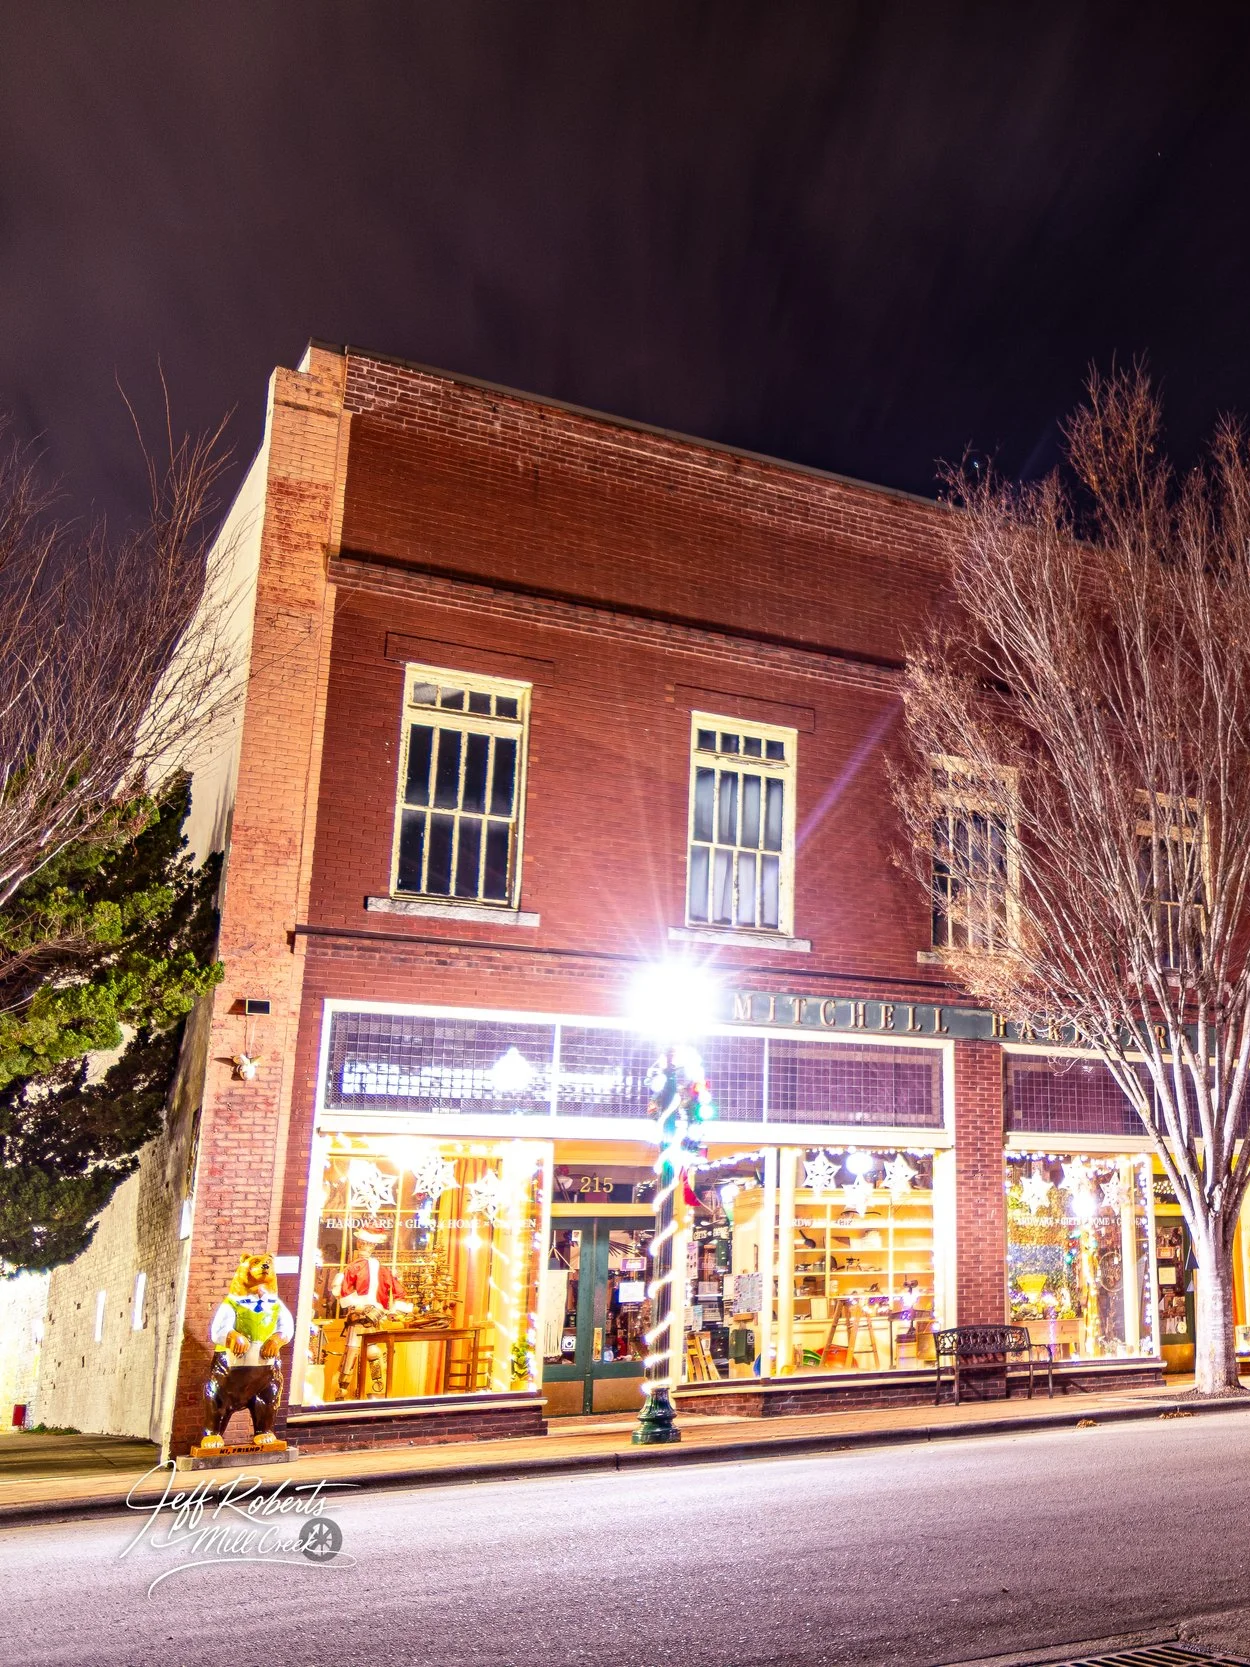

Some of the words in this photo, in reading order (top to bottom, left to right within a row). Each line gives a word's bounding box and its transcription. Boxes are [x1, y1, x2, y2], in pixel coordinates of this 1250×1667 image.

[733, 991, 949, 1034] MITCHELL
[580, 1176, 614, 1193] 215
[326, 1219, 393, 1229] HARDWARE
[232, 1445, 264, 1454] FRIEND!
